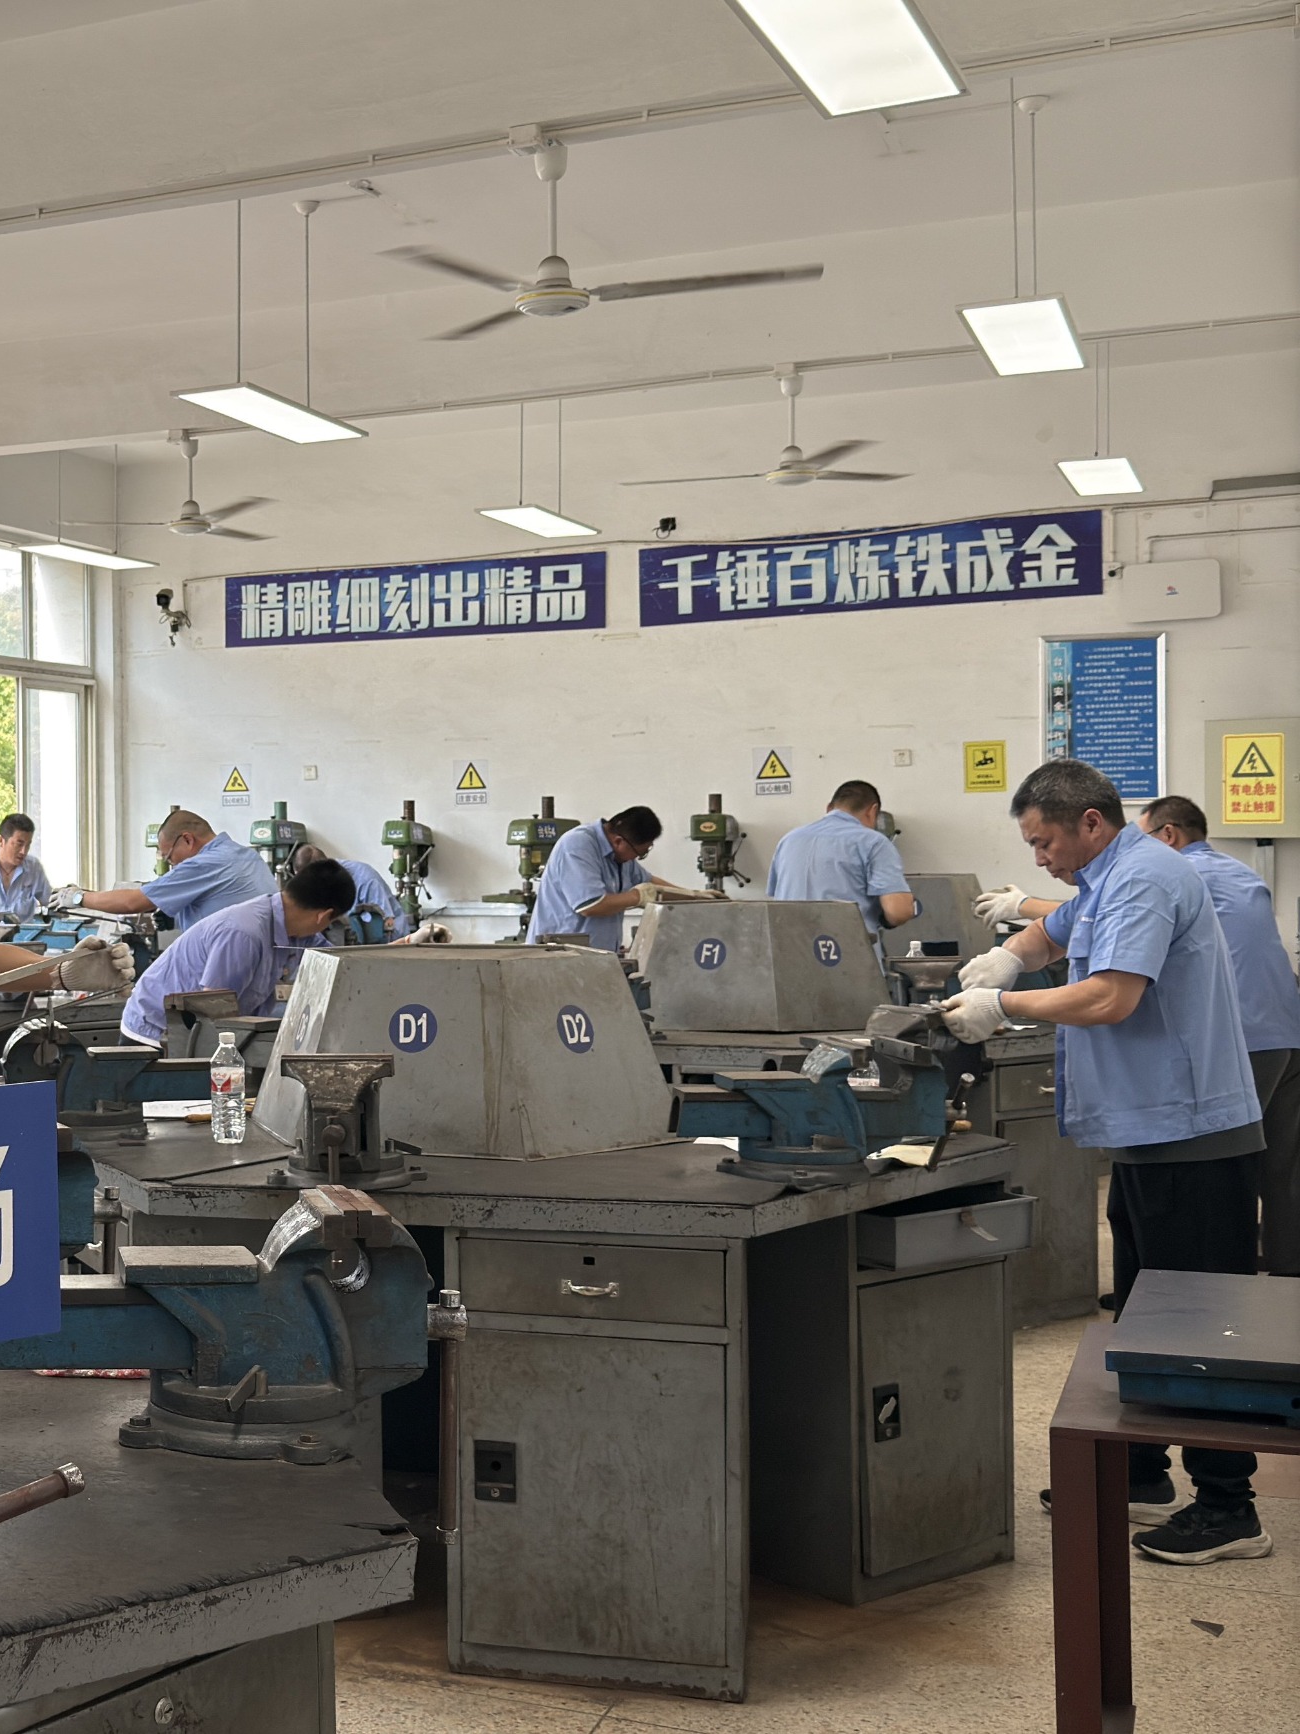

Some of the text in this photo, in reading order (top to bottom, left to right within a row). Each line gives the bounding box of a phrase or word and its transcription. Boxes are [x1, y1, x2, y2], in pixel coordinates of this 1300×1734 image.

[658, 523, 1080, 615] 千锤百炼铁成金
[241, 564, 587, 639] 精雕细刻出精品
[1229, 781, 1277, 796] 有电危险
[1231, 801, 1275, 813] 禁止触摸
[700, 944, 720, 964] F1
[818, 940, 838, 960] F2
[399, 1013, 427, 1044] D1
[562, 1013, 590, 1044] D2
